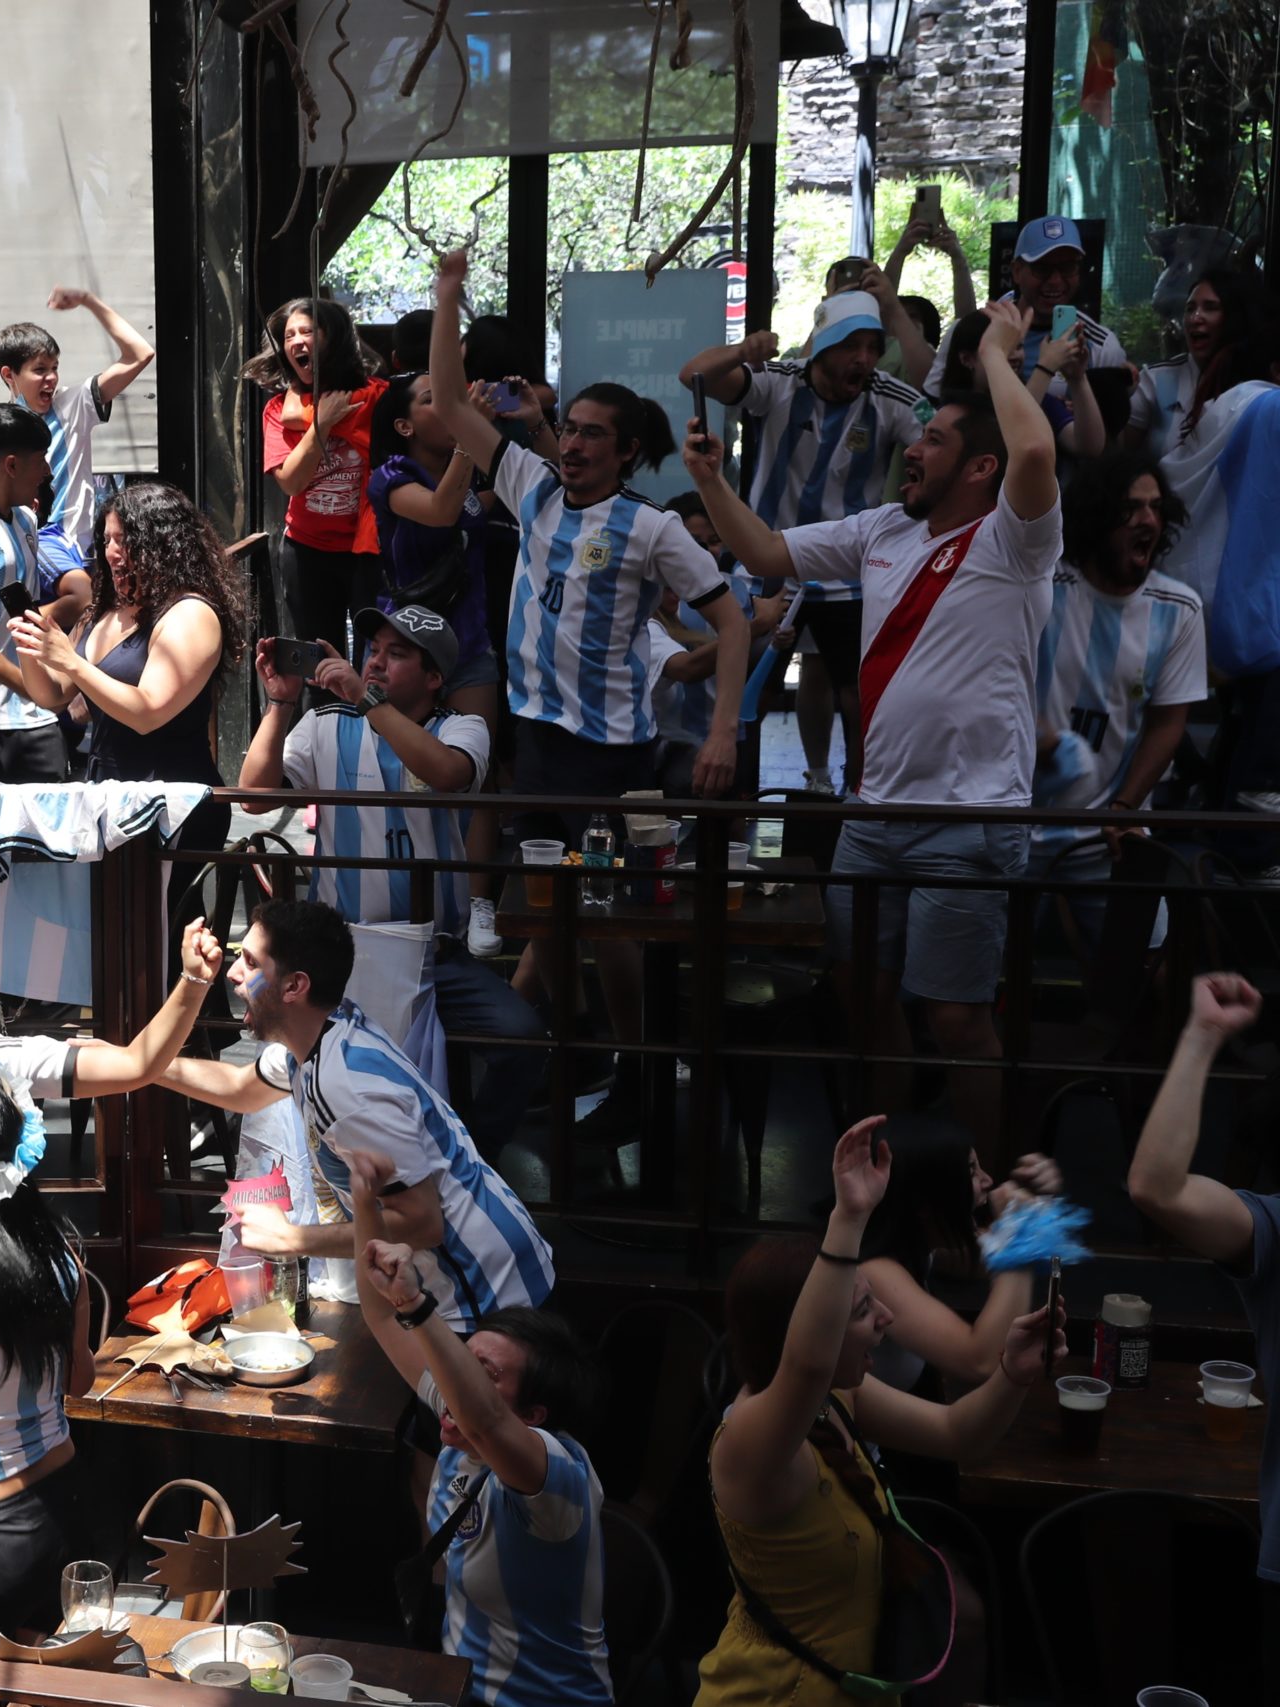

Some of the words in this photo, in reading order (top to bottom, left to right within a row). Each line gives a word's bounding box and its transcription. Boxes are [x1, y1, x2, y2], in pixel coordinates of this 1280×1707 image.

[868, 558, 893, 569] arathon
[539, 577, 564, 615] 10
[385, 828, 415, 859] 10
